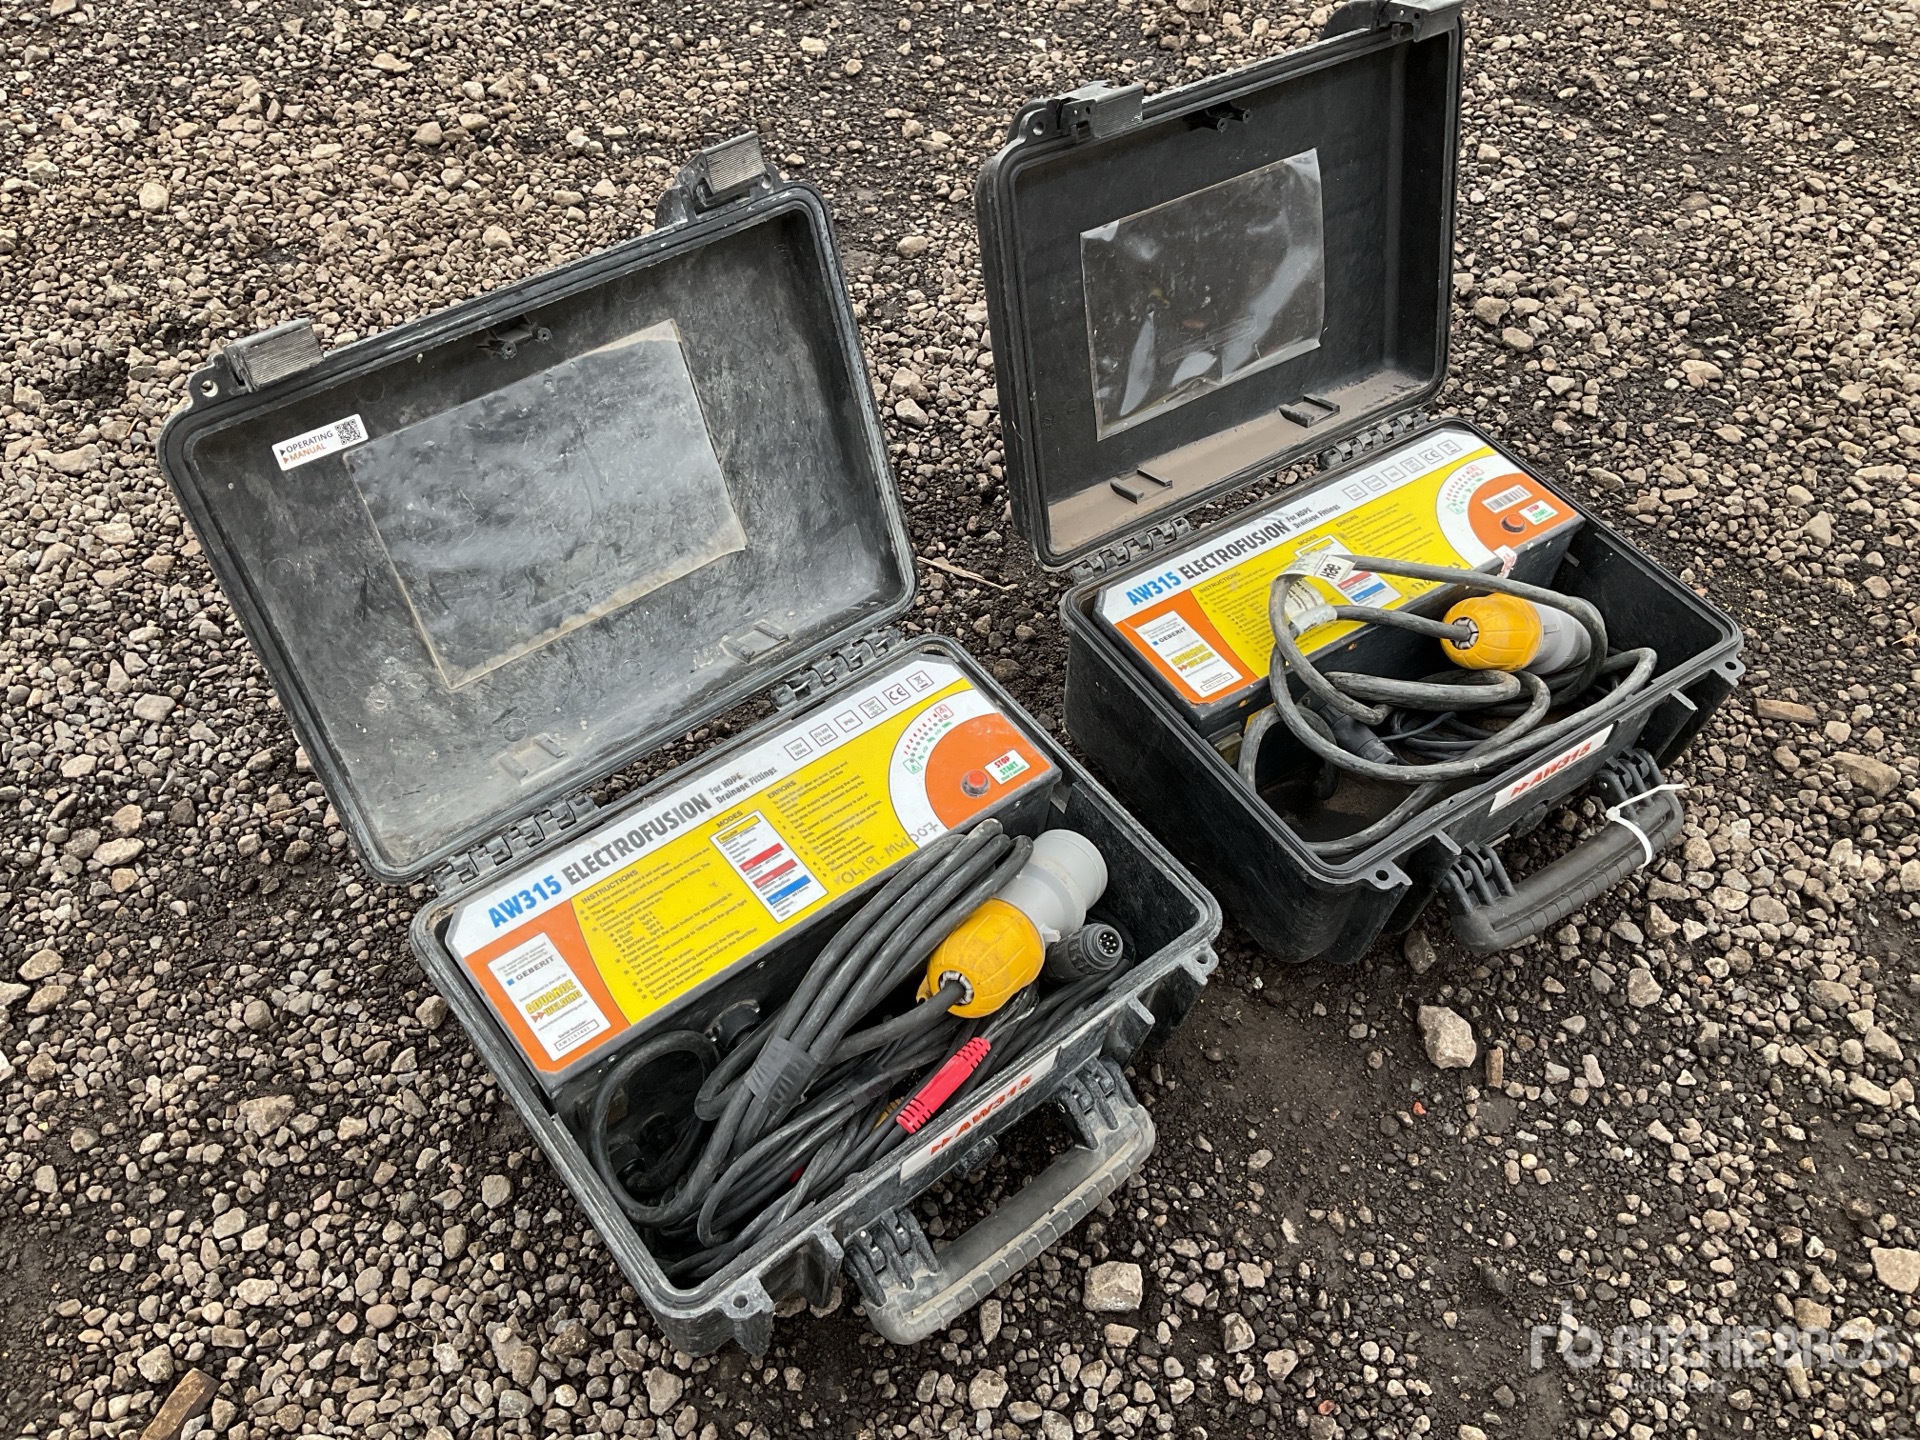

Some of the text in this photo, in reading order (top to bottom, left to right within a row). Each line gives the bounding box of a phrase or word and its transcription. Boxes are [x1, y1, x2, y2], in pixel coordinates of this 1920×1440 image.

[286, 430, 333, 453] OPERATING
[289, 443, 327, 462] MANUAL
[1284, 506, 1313, 522] For HDPE
[1291, 503, 1341, 529] Drainage Fittings
[1334, 514, 1359, 527] ERRORS
[1296, 533, 1318, 545] MODES
[1122, 570, 1184, 606] AW315
[1176, 519, 1293, 580] ELECTROFUSION
[1197, 570, 1241, 593] INSTRUCTIONS
[1157, 626, 1187, 643] GEBERIT
[993, 755, 1011, 768] STOP
[998, 760, 1019, 775] START
[1530, 742, 1592, 787] AW315
[707, 771, 744, 796] For HDPE
[714, 764, 779, 804] Drainage Fittings
[766, 779, 797, 799] ERRORS
[715, 809, 744, 828] MODES
[483, 792, 713, 928] AW315 ELECTROFUSION
[580, 868, 639, 904] INSTRUCTIONS
[514, 955, 555, 981] GEBERIT
[523, 978, 577, 1014] ADVANCE
[542, 988, 583, 1017] WELDING
[956, 1074, 1032, 1137] AW315
